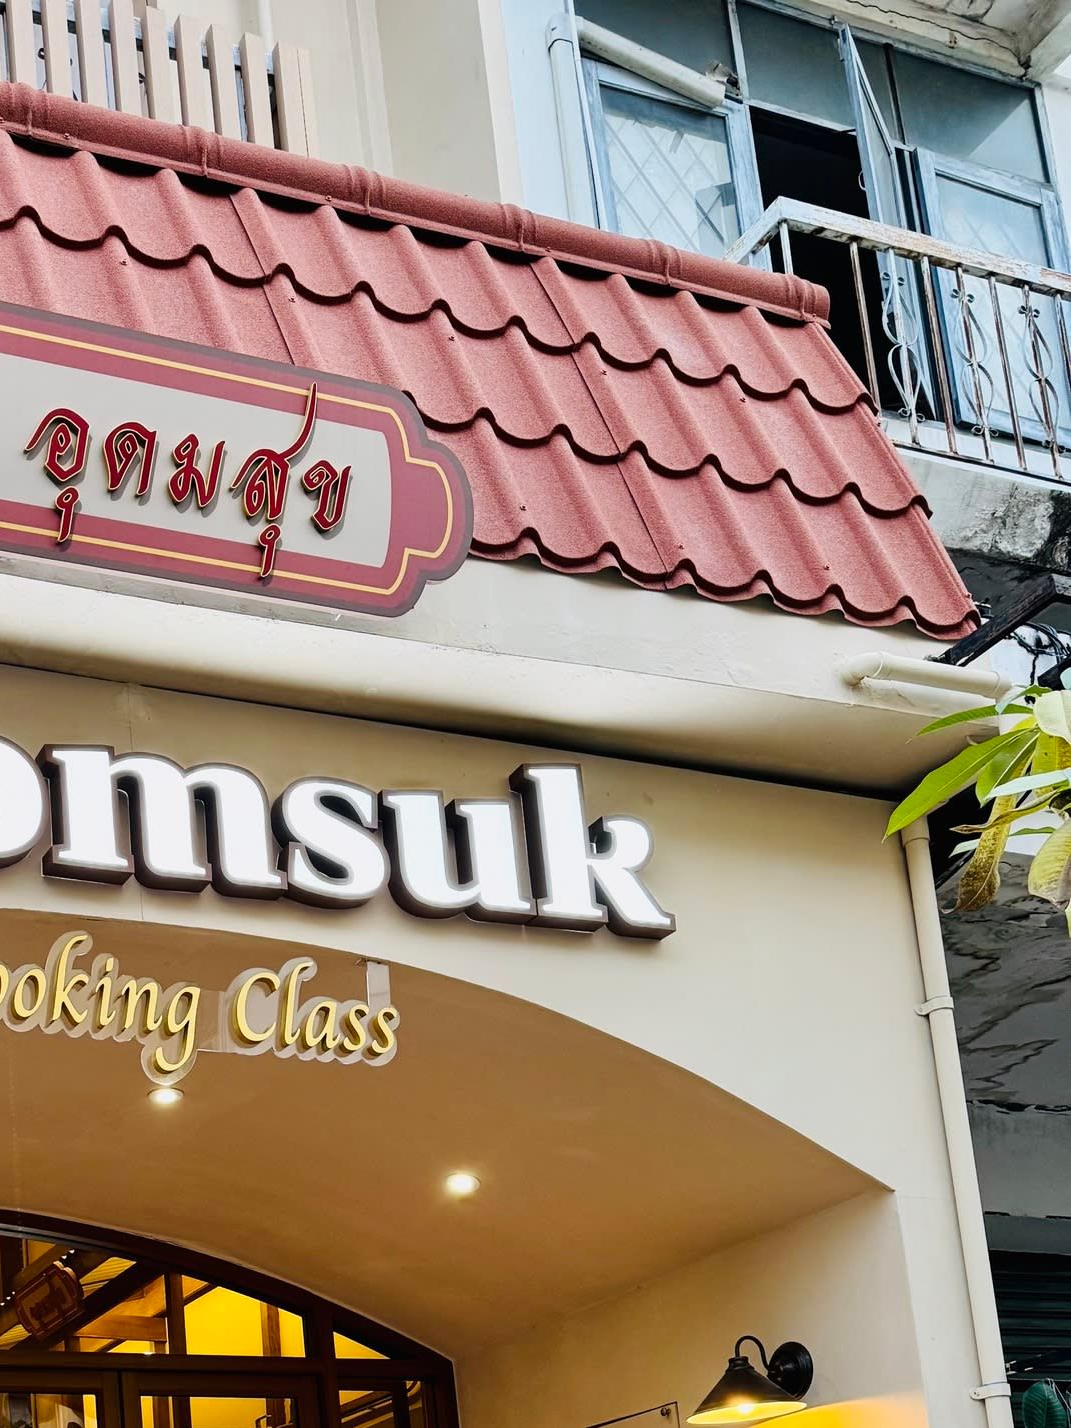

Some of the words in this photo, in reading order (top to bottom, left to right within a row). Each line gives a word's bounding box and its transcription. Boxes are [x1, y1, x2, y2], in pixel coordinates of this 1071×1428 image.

[25, 381, 351, 578] อุดมสุข
[234, 957, 397, 1056] Class
